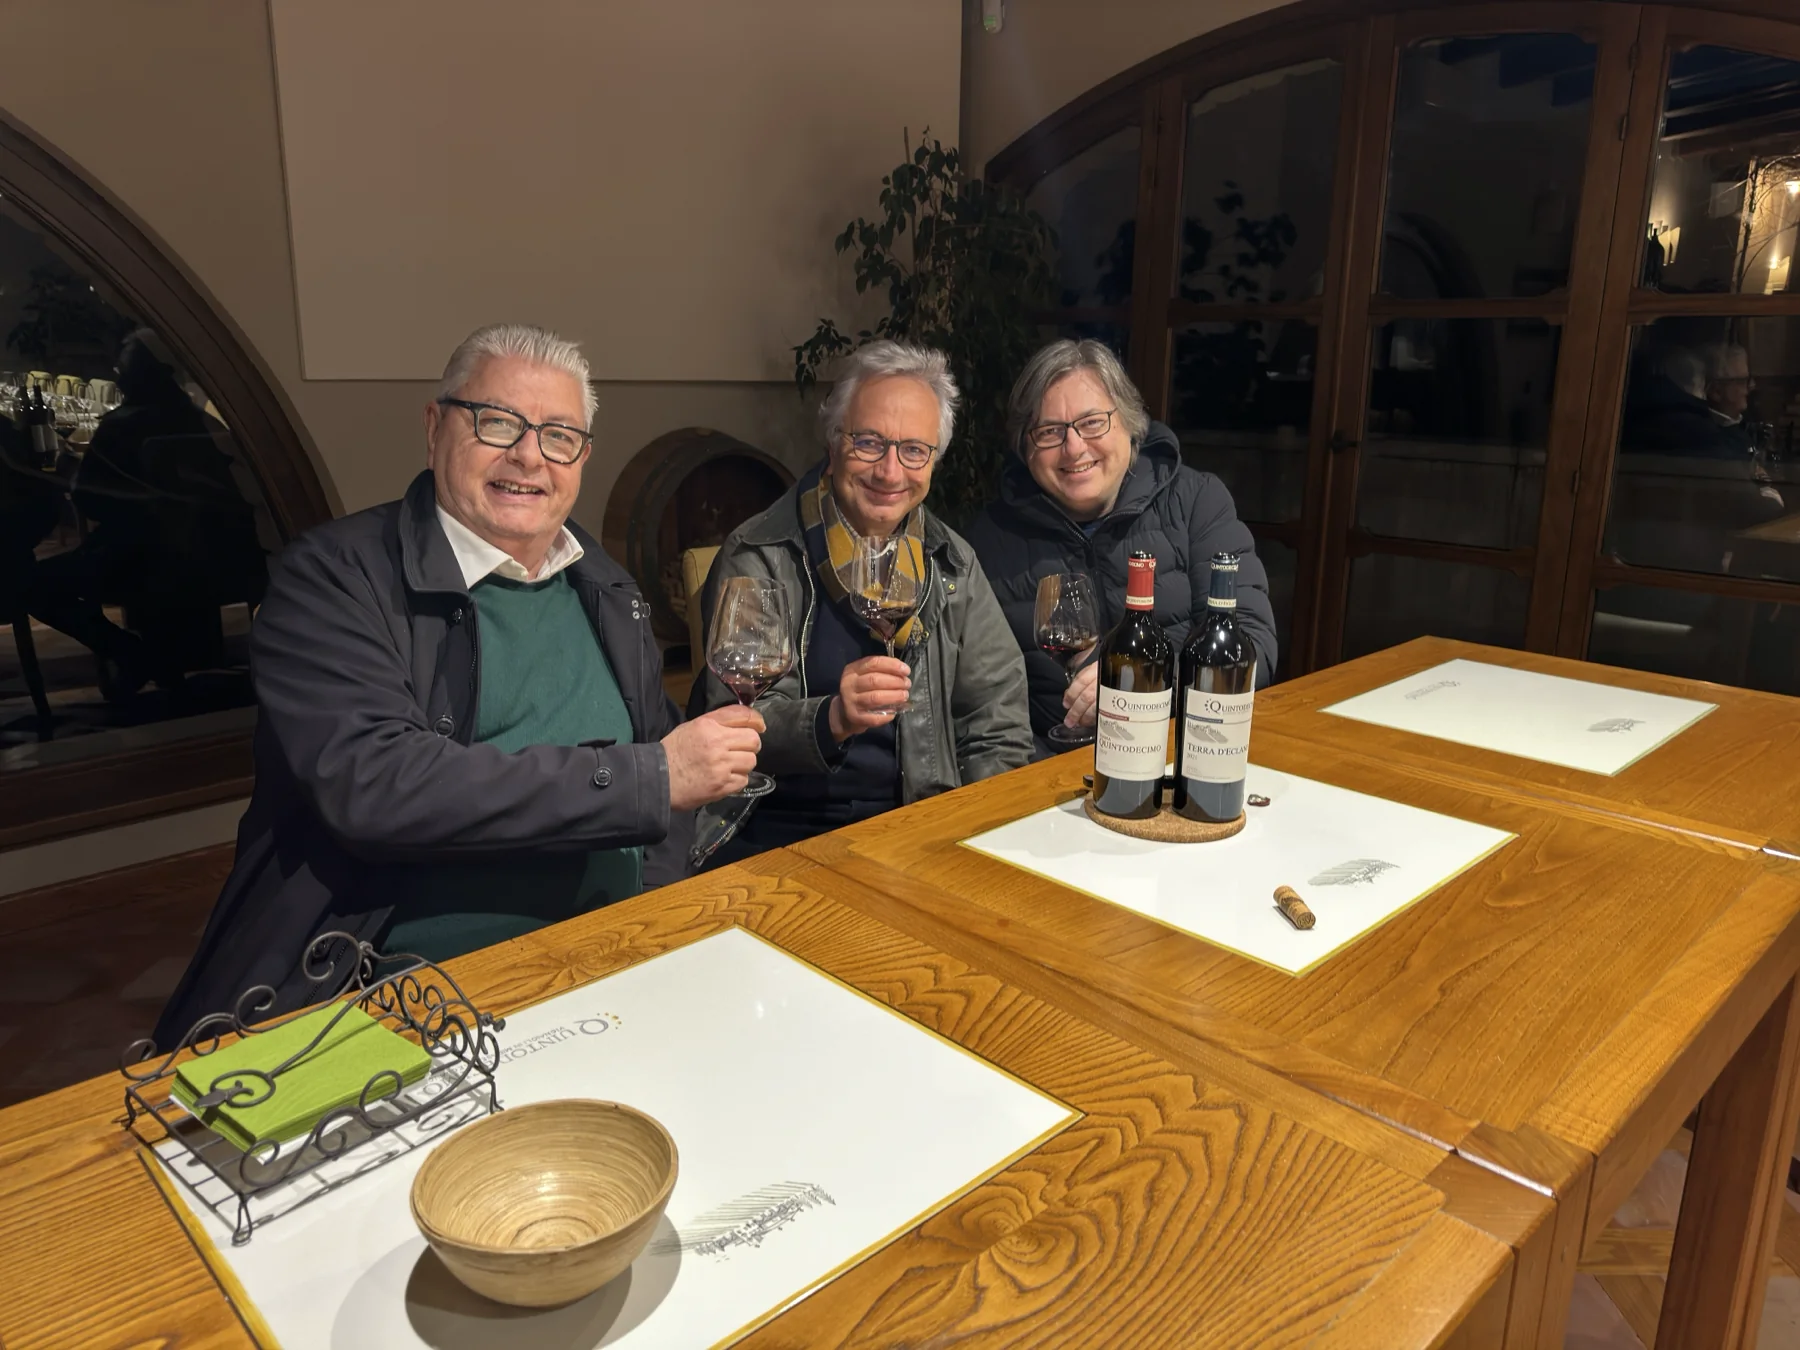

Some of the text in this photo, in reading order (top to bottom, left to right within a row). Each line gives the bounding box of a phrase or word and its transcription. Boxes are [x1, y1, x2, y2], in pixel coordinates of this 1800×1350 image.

[1116, 697, 1170, 712] QUINTODECIM
[1098, 739, 1162, 755] QUINTODECIMO
[1187, 742, 1248, 756] TERRA D'ECLAN
